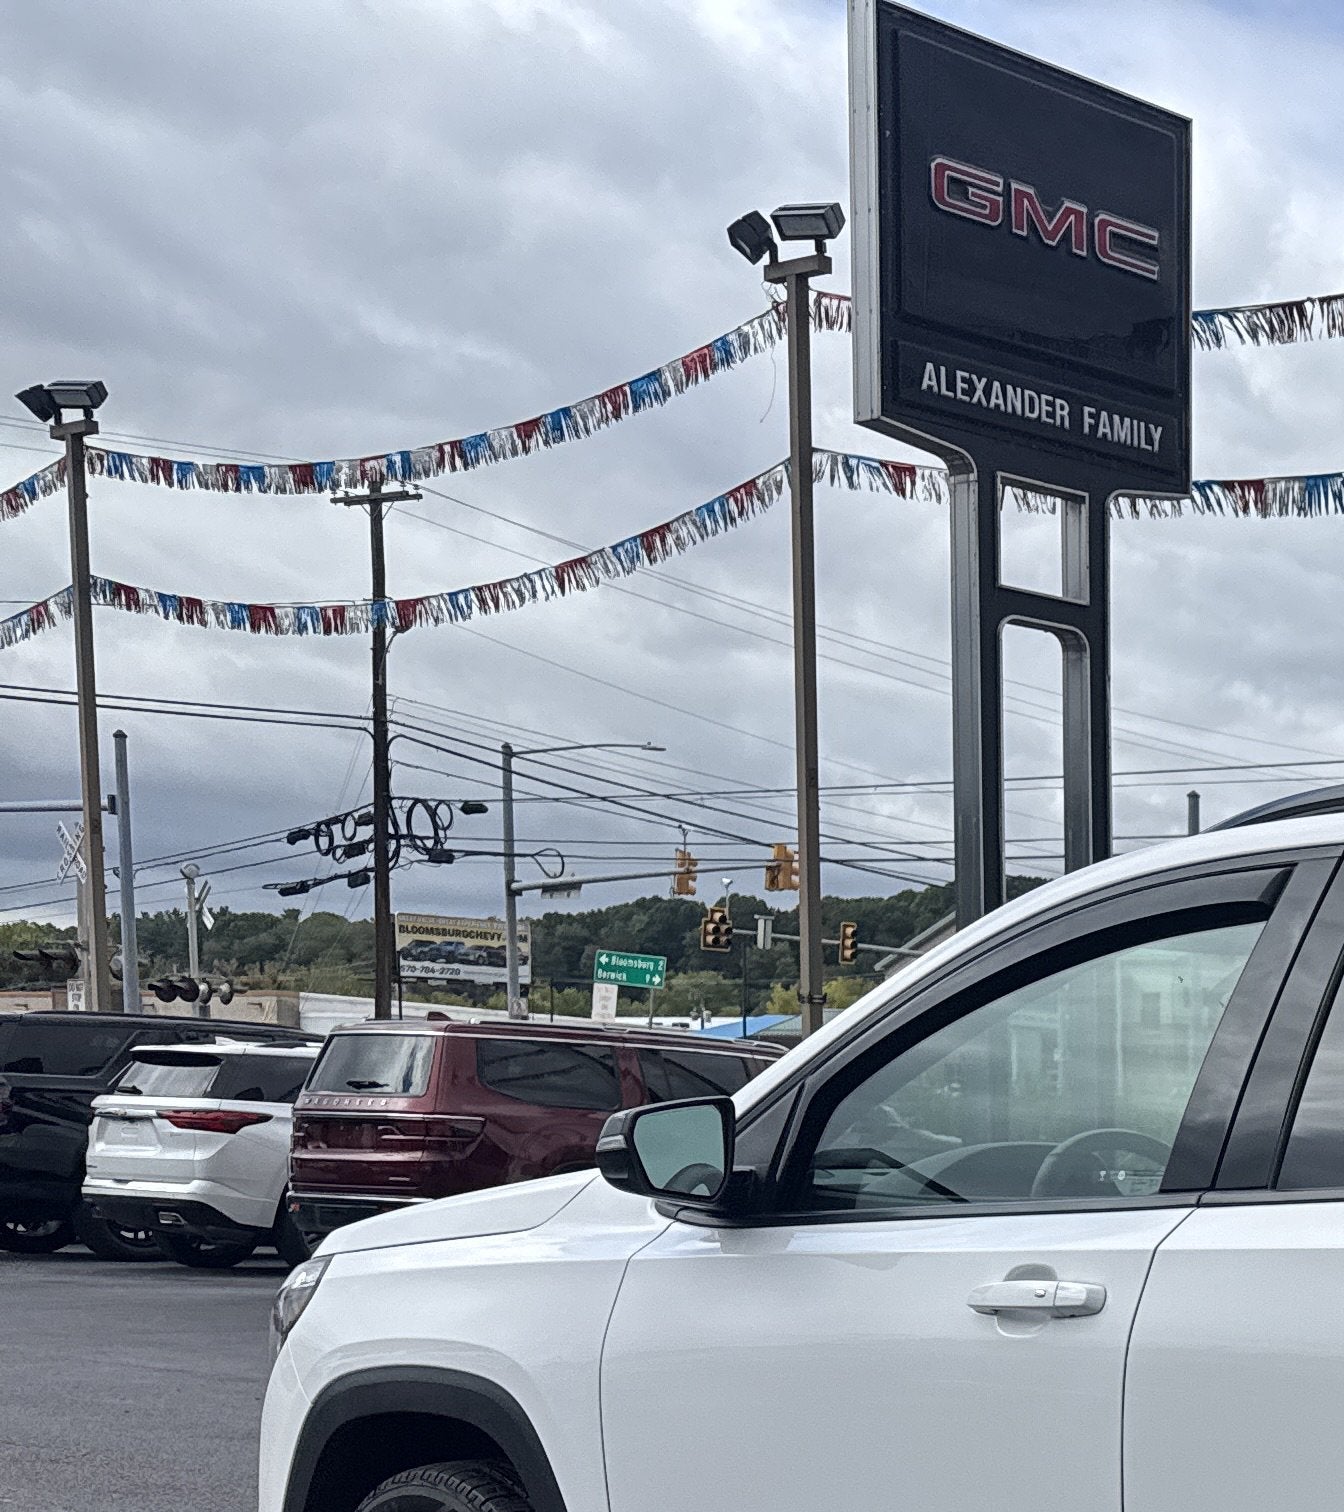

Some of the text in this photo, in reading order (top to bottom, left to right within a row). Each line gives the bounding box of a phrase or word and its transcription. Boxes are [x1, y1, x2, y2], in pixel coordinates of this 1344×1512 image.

[930, 156, 1160, 281] GMC
[921, 361, 1163, 454] ALEXANDER FAMILY
[56, 824, 88, 879] RAILOAD
[398, 924, 528, 943] BLOOMSBURGCHEVY.M
[610, 955, 664, 972] Bloomsburg 2
